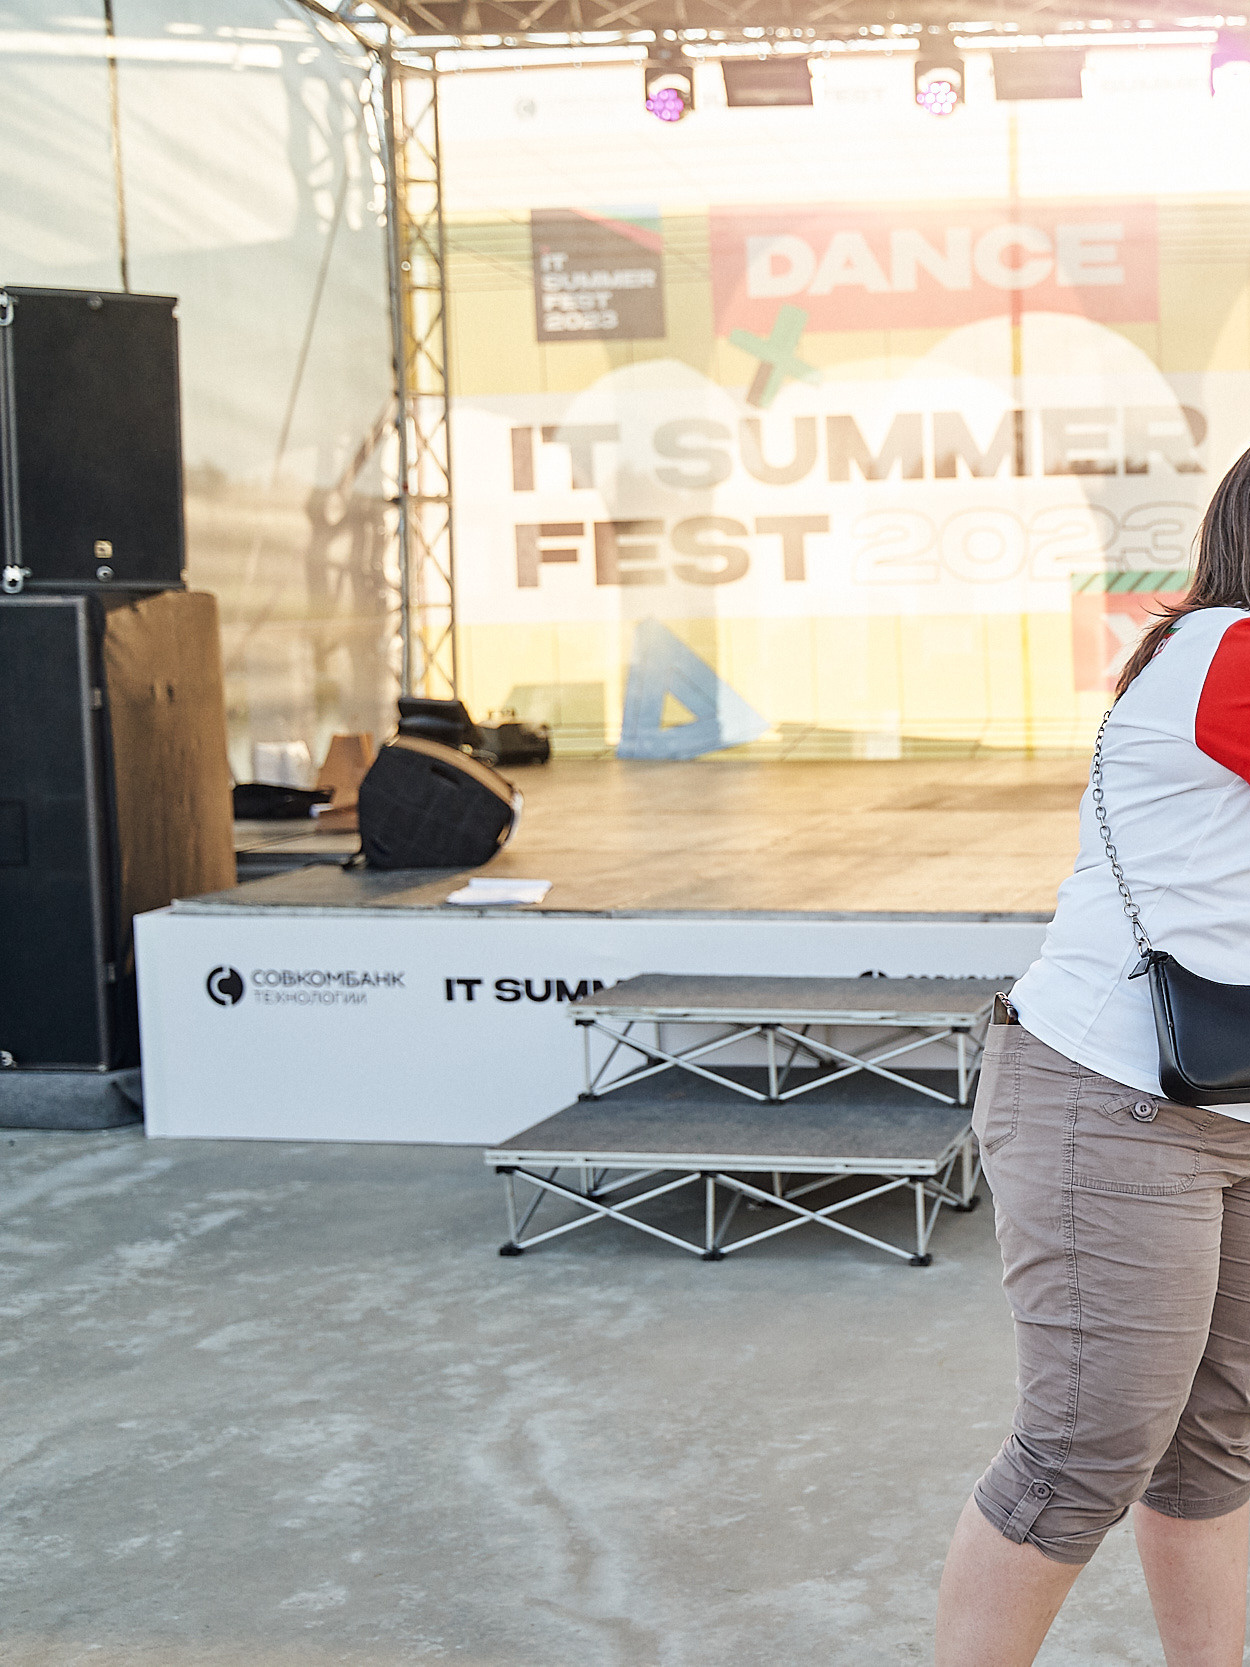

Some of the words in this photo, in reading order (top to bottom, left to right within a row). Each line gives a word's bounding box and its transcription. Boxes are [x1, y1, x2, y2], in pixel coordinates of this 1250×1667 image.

[541, 251, 568, 273] IT
[745, 222, 1125, 299] DANCE
[541, 268, 657, 292] SUMMER
[541, 290, 614, 312] FEST
[510, 424, 620, 492] IT
[651, 405, 1209, 490] SUMMER
[515, 514, 830, 588] FEST
[848, 502, 1205, 585] 2023
[252, 969, 406, 988] СОВКОМБАНК
[445, 978, 483, 1002] IT
[254, 990, 368, 1006] ТЕХНОЛОГИИ
